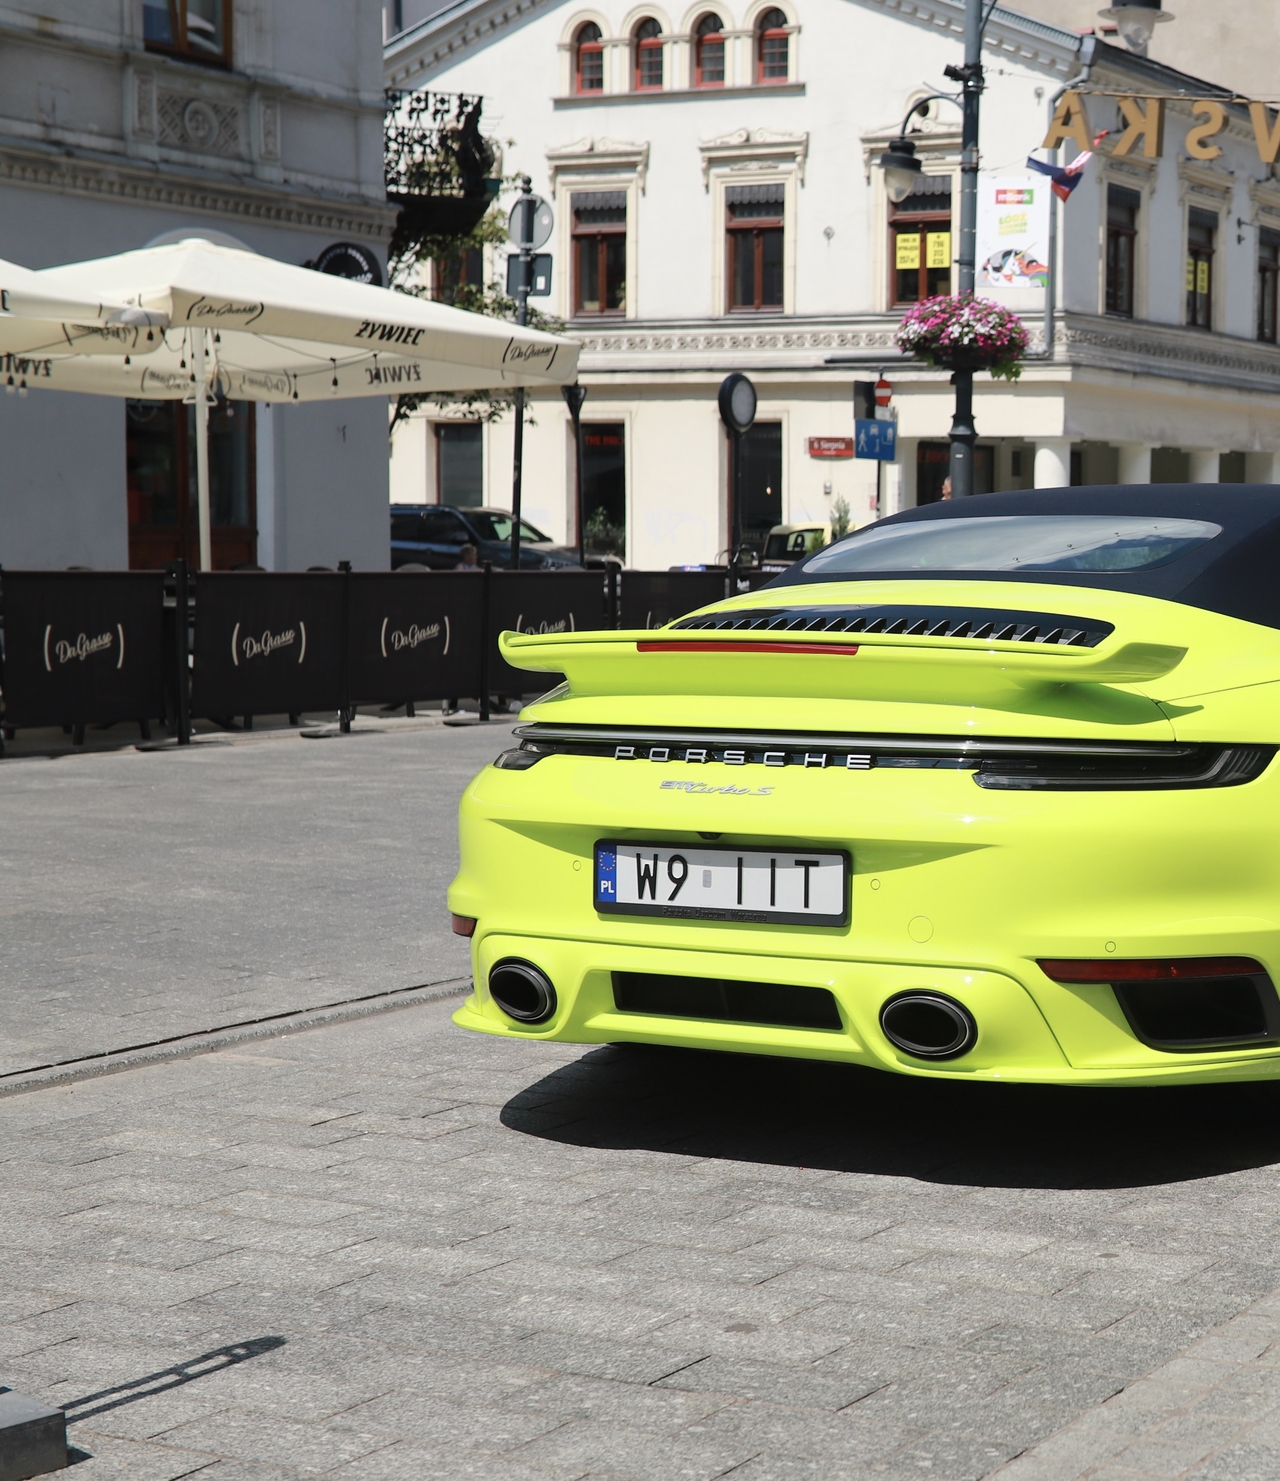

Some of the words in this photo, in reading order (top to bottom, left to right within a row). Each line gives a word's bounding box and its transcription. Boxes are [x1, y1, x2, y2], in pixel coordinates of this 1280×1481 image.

[354, 319, 425, 346] ŻYWIEC
[813, 441, 819, 450] 6
[820, 440, 846, 452] Sierpnia
[614, 746, 873, 770] PORSCHE
[636, 852, 689, 902] W9
[600, 880, 615, 894] PL
[662, 906, 692, 918] Porsche
